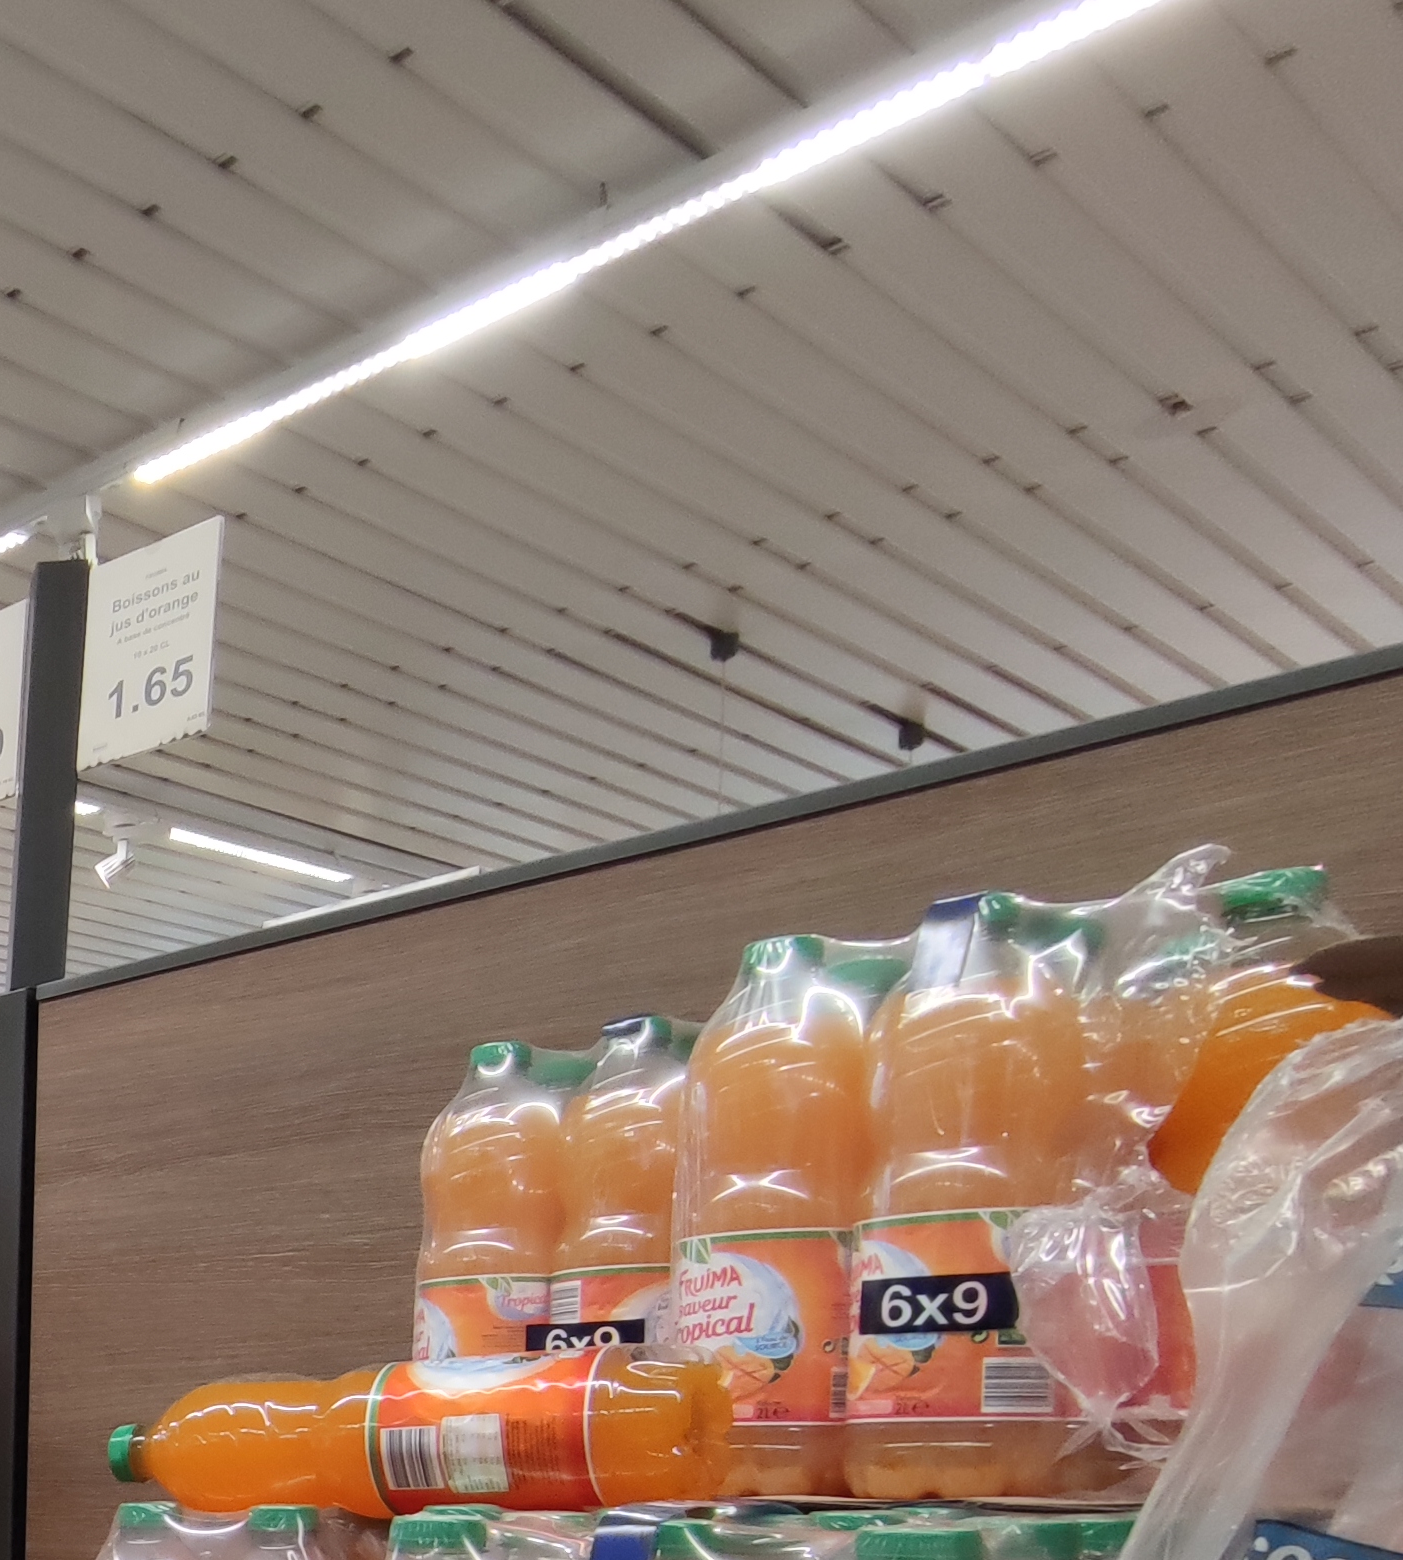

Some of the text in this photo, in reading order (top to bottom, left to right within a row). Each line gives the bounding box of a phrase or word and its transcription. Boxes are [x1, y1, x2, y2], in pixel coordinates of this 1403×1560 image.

[109, 591, 199, 638] jus d'orange
[112, 577, 178, 613] Boissons
[182, 569, 200, 585] au
[107, 655, 194, 720] 1.65
[675, 1302, 756, 1345] ropical
[880, 1280, 989, 1328] 6x9
